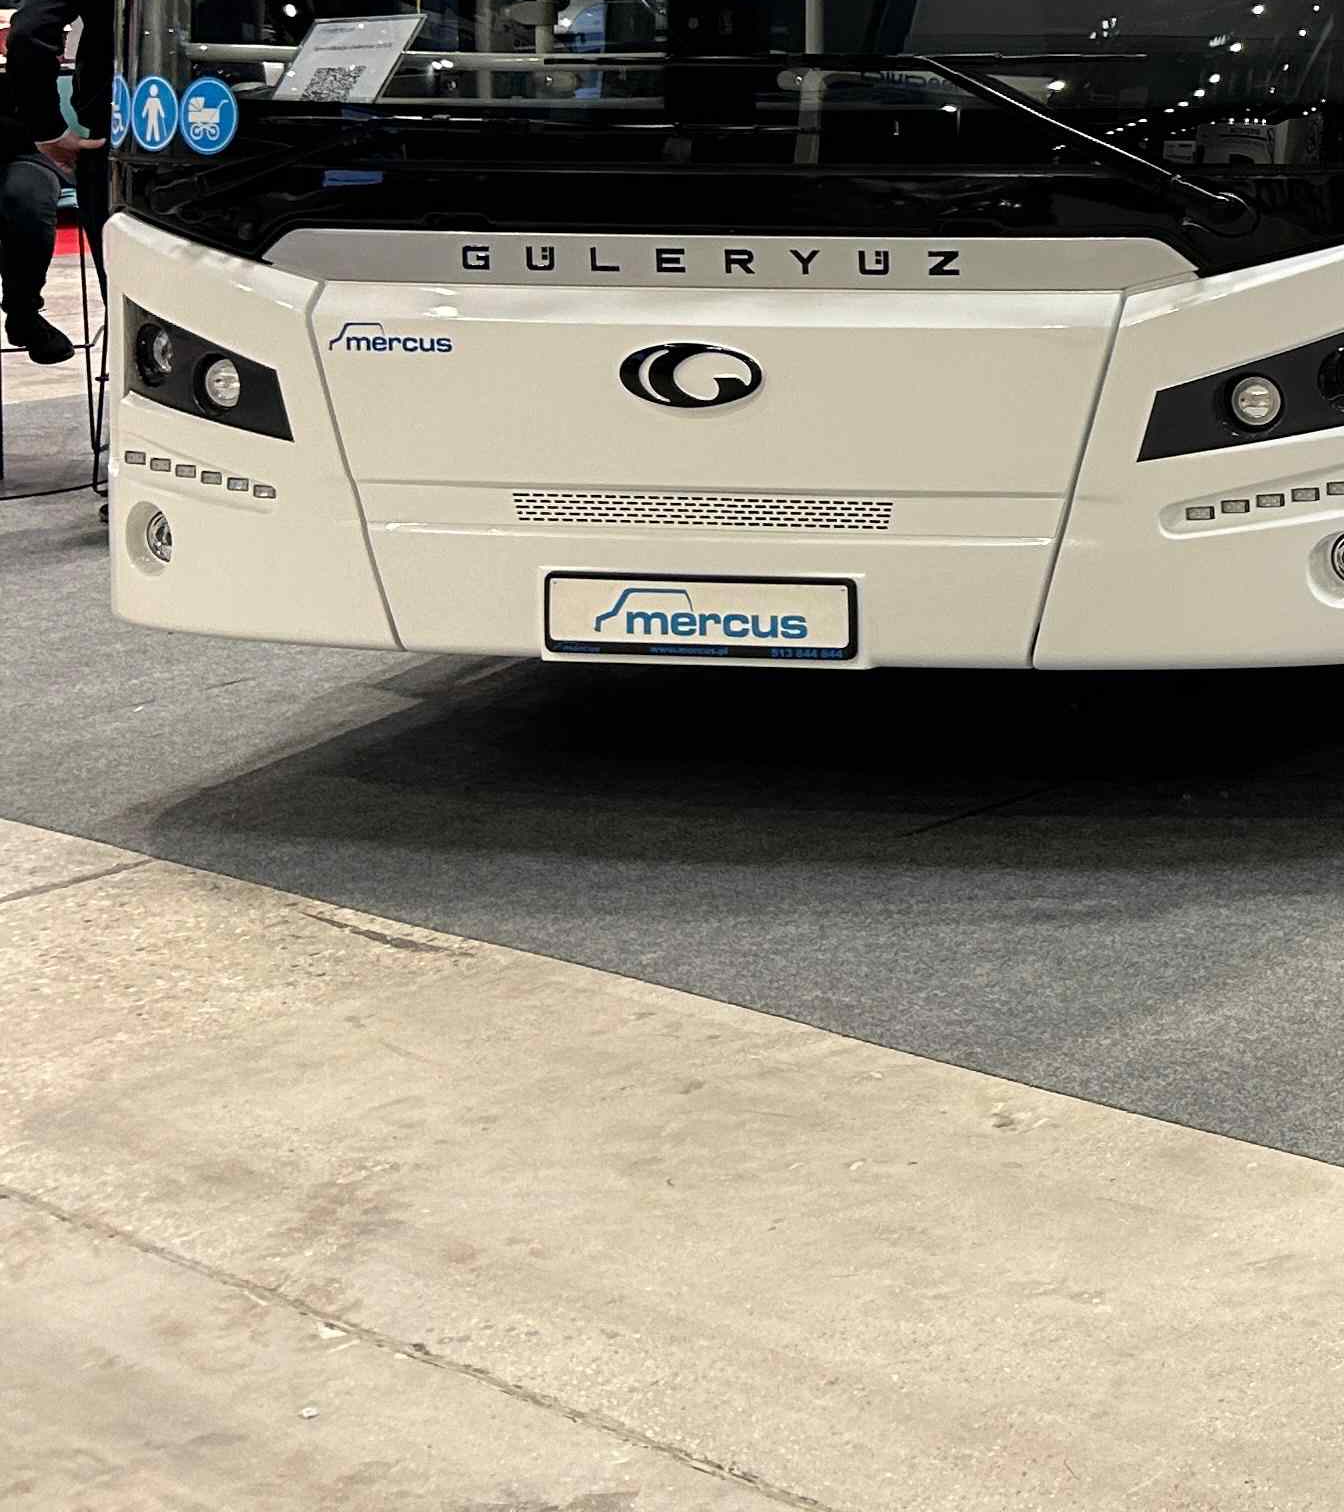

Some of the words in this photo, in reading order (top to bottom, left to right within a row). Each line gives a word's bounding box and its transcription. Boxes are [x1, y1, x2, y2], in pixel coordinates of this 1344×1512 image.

[461, 245, 961, 276] GÜLERYÜZ
[345, 335, 453, 353] mercus
[625, 610, 808, 639] mercus
